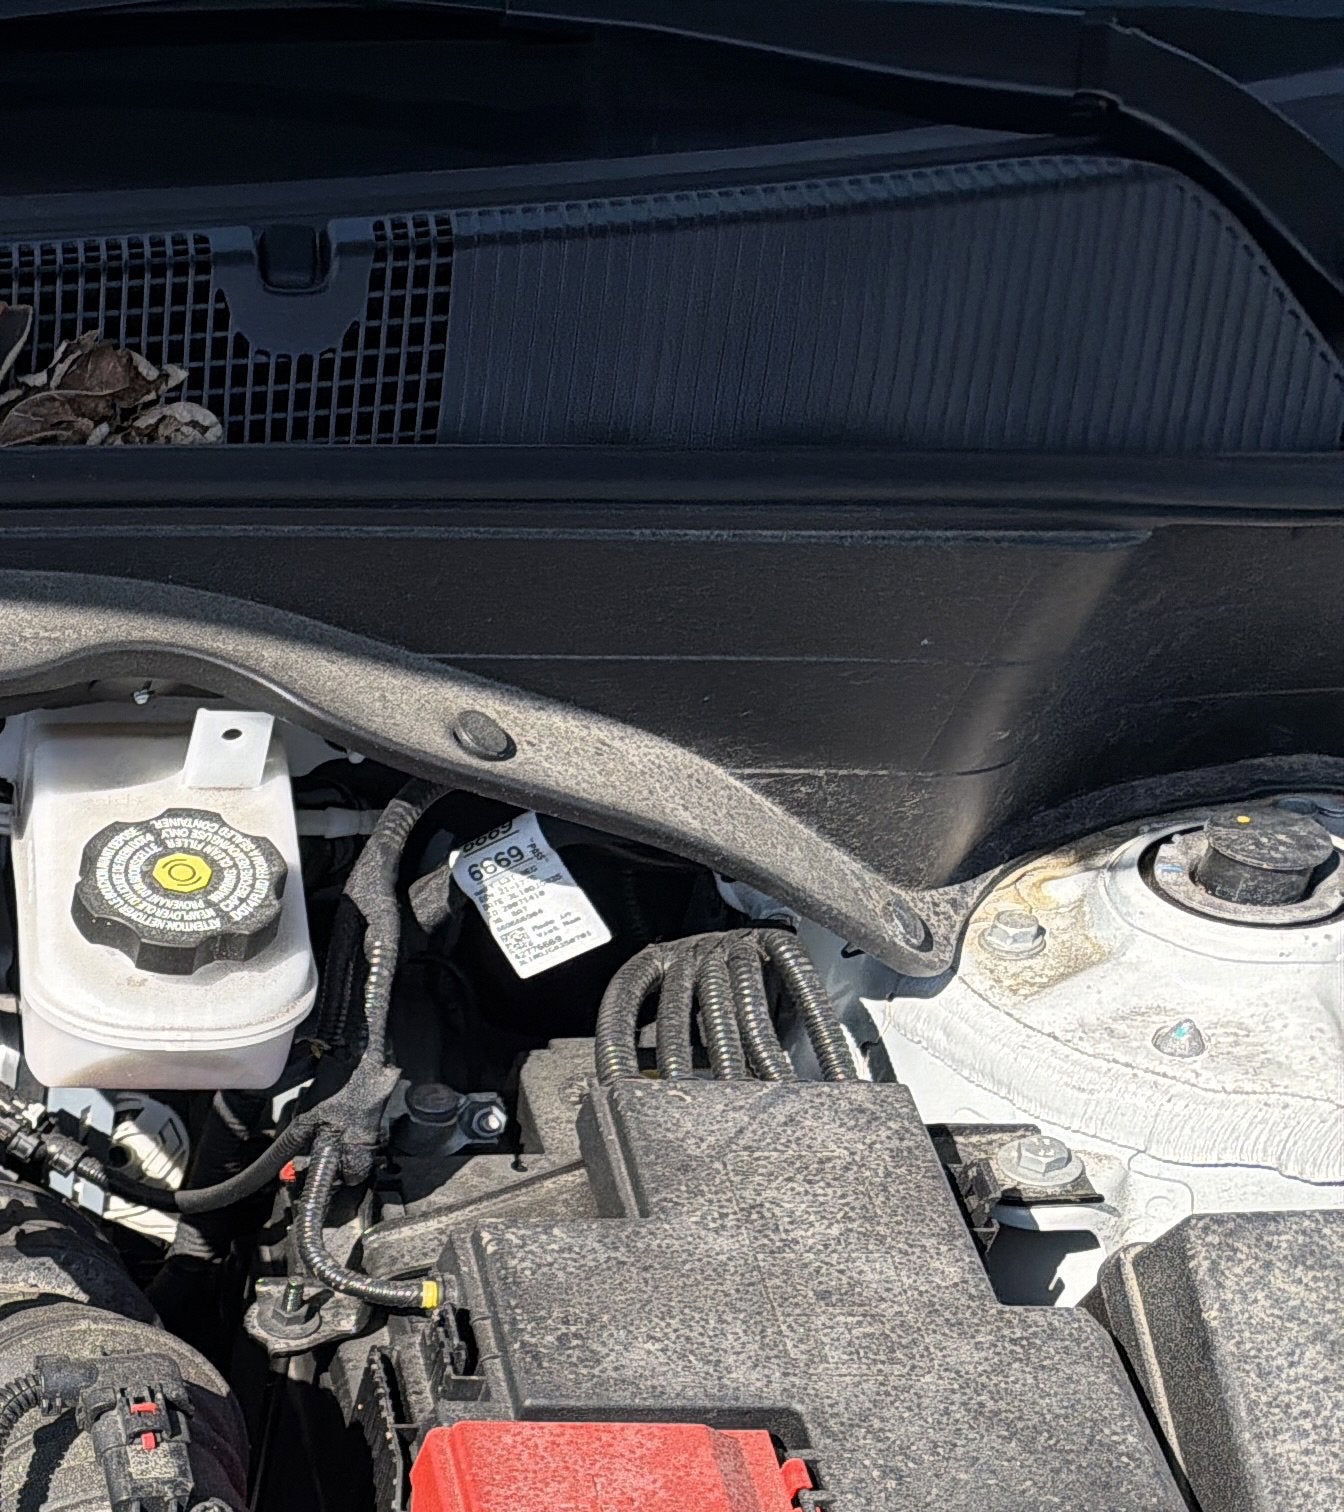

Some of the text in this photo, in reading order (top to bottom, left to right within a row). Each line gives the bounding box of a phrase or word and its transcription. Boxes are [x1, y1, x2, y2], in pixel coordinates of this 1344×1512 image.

[157, 827, 188, 839] ONLY
[190, 828, 215, 840] USE
[164, 838, 207, 850] FILLER
[467, 845, 525, 882] 6669
